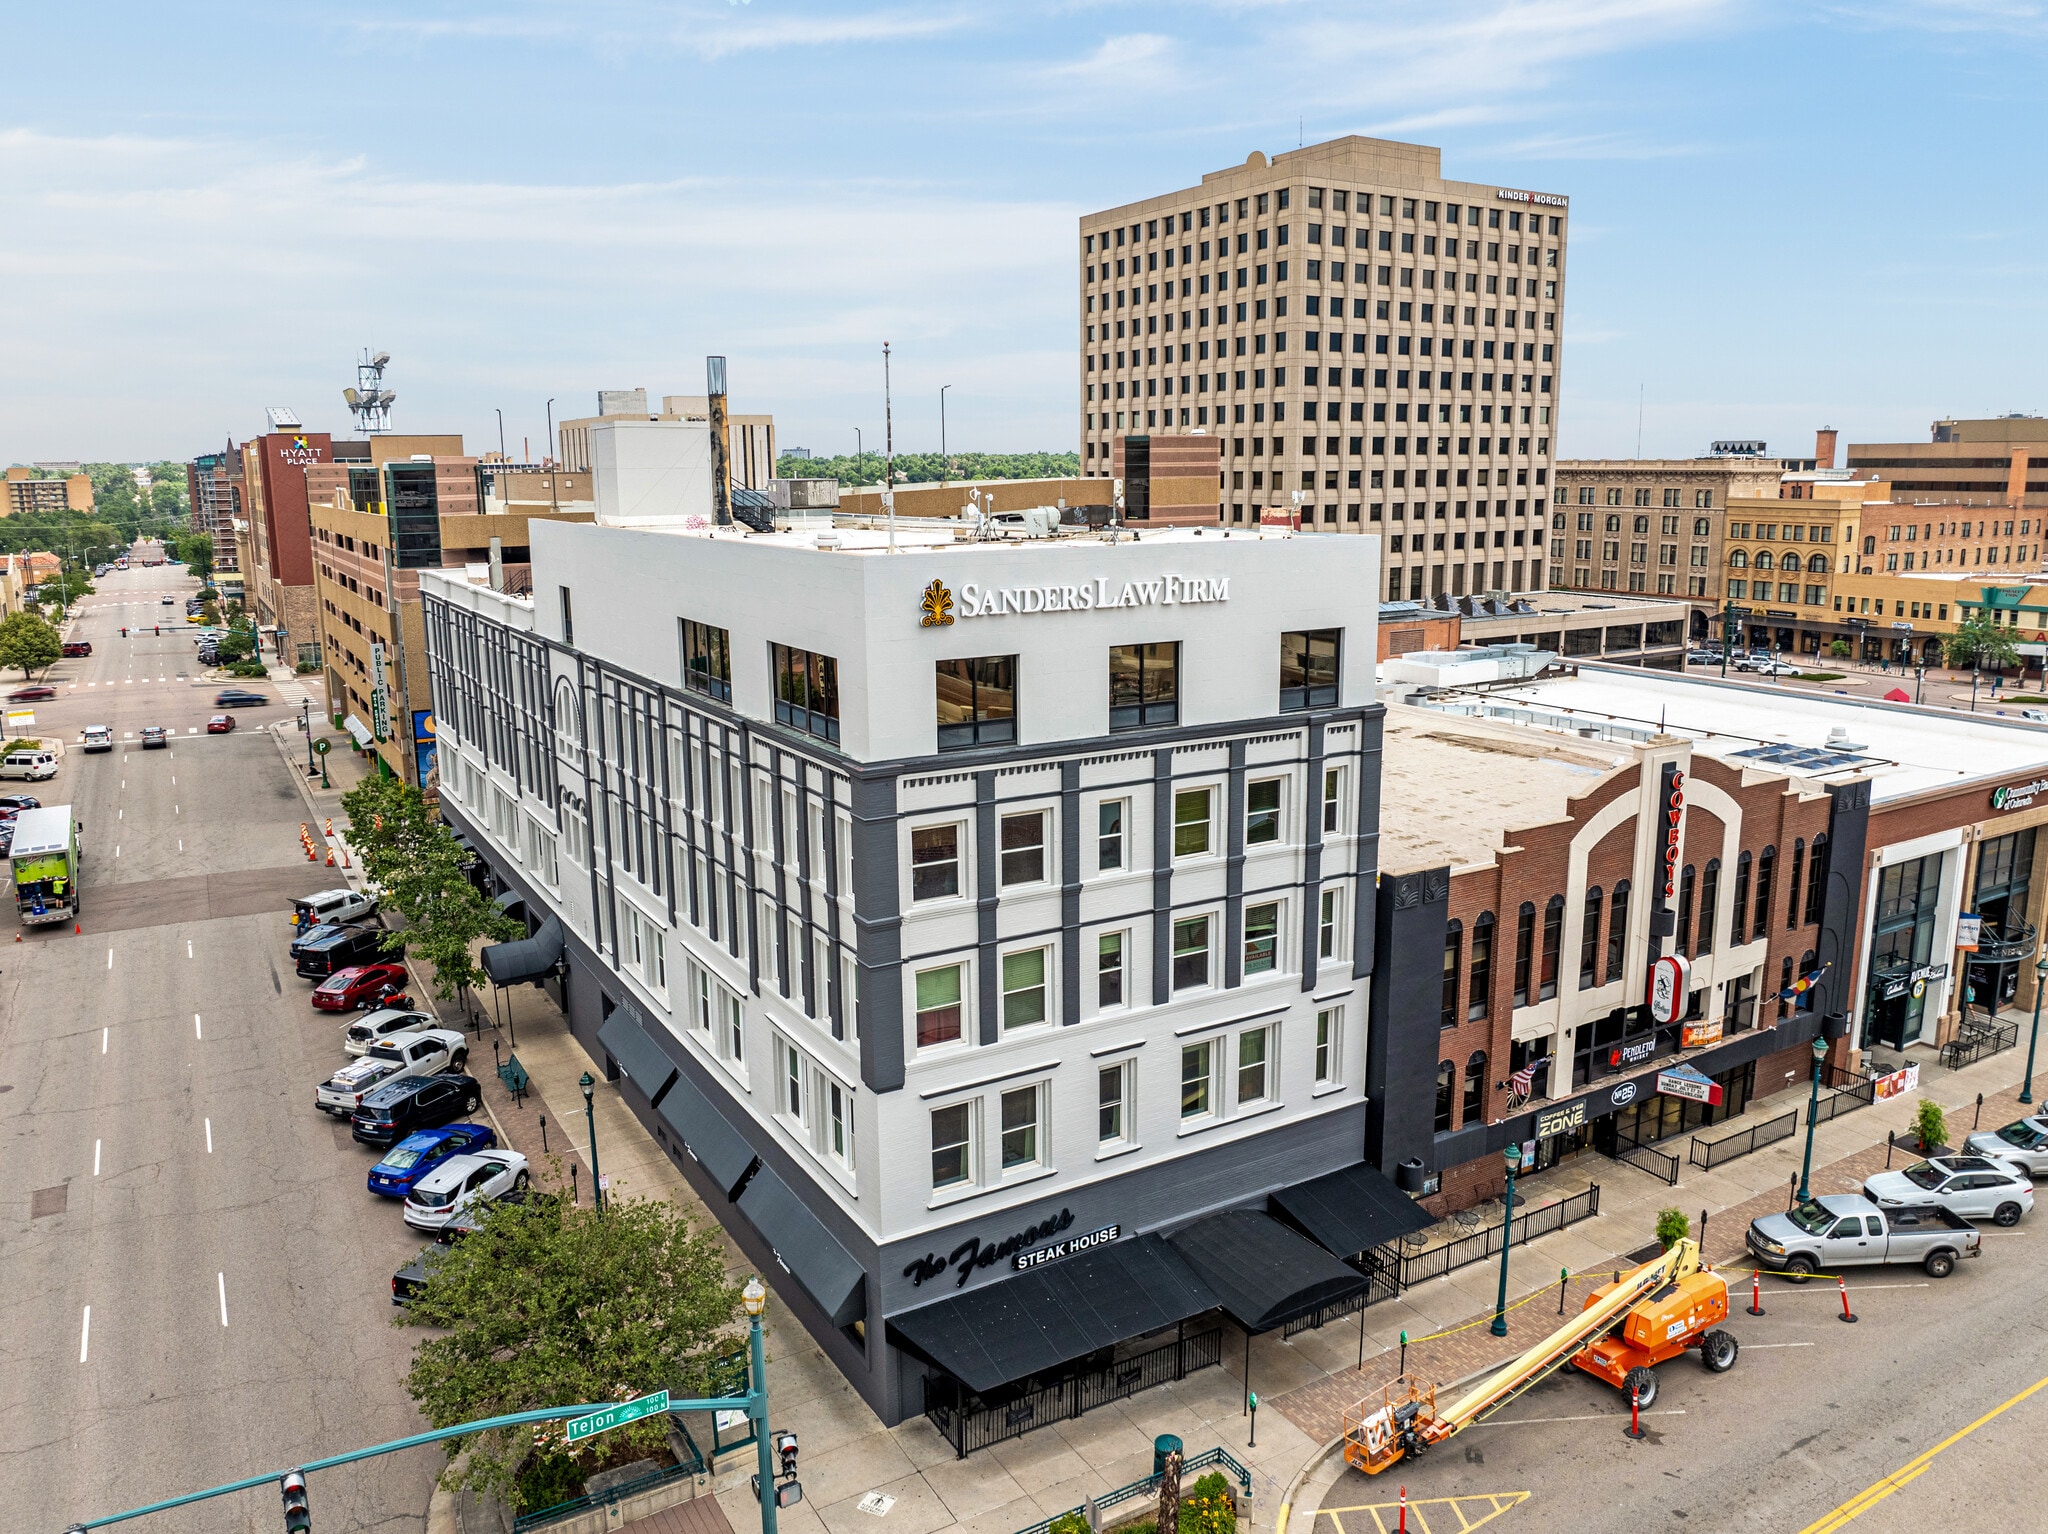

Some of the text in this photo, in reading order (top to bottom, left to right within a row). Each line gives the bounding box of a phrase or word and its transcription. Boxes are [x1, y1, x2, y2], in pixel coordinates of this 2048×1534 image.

[1498, 189, 1568, 207] KINDER MORGAN
[280, 448, 322, 458] HYATT
[287, 457, 318, 465] PLACE
[374, 647, 389, 733] PUBLIC PARKING
[319, 742, 326, 752] P
[1665, 772, 1684, 898] COWBOYS
[1622, 1037, 1656, 1061] PENDLETON
[1661, 1081, 1678, 1089] SUNDAY
[1540, 1108, 1565, 1122] COFFEE
[1571, 1103, 1584, 1112] TEA
[1539, 1109, 1584, 1137] ZONE
[1017, 1226, 1119, 1270] STEAK HOUSE
[571, 1412, 615, 1435] Tejon
[646, 1396, 659, 1405] 100
[645, 1405, 659, 1414] 100
